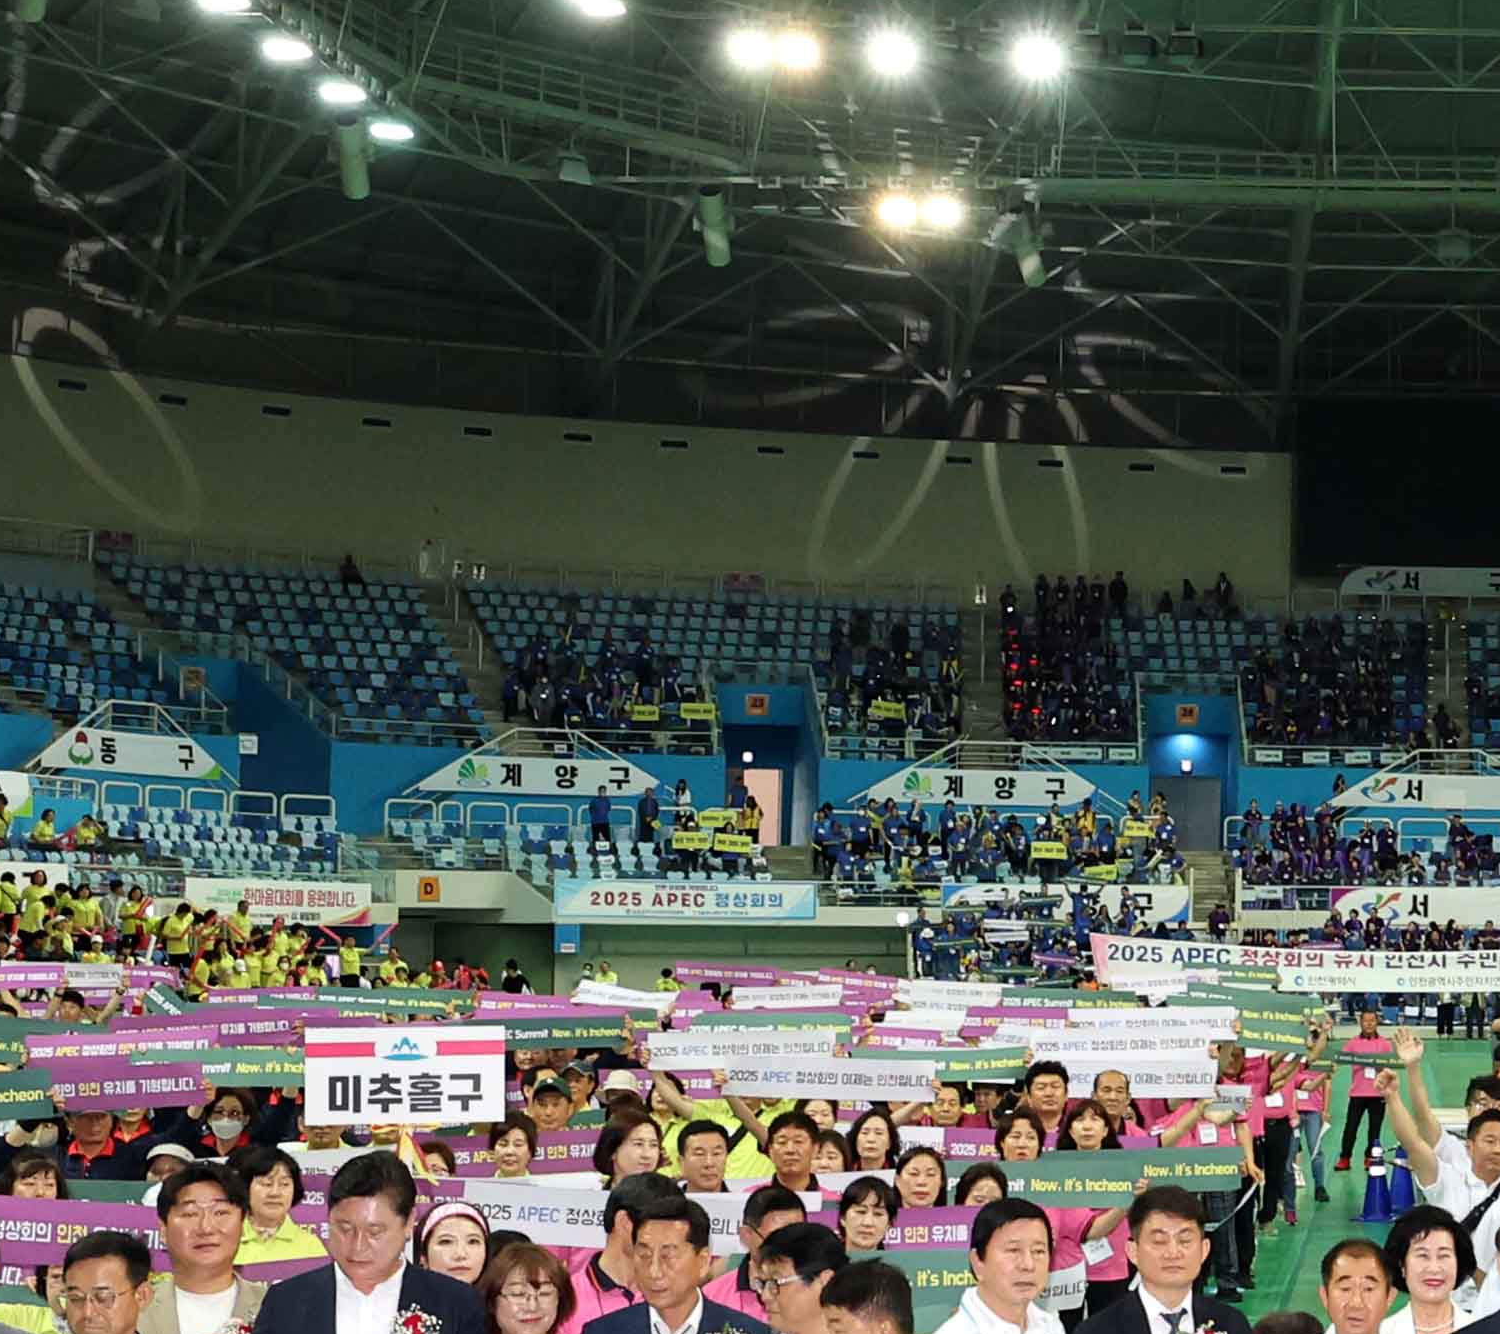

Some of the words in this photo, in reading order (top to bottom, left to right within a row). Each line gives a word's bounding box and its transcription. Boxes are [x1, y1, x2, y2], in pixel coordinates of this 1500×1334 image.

[100, 737, 194, 771] 동구
[501, 764, 631, 790] 계양구
[943, 775, 1066, 800] 계양구
[244, 887, 304, 907] 한마음대회를
[307, 889, 356, 908] 응원합니다.
[424, 881, 433, 895] D
[590, 891, 642, 906] 2025
[652, 891, 705, 908] APEC
[716, 892, 782, 908] 정상회의
[1108, 944, 1166, 963] 2025
[1171, 947, 1230, 964] APEC
[1240, 948, 1323, 966] 정상회의
[729, 1071, 759, 1083] 2025
[762, 1071, 792, 1084] APEC
[795, 1072, 838, 1086] 정상회의
[841, 1072, 873, 1087] 이제는
[877, 1073, 931, 1088] 인천입니다
[328, 1073, 483, 1114] 미추홀구
